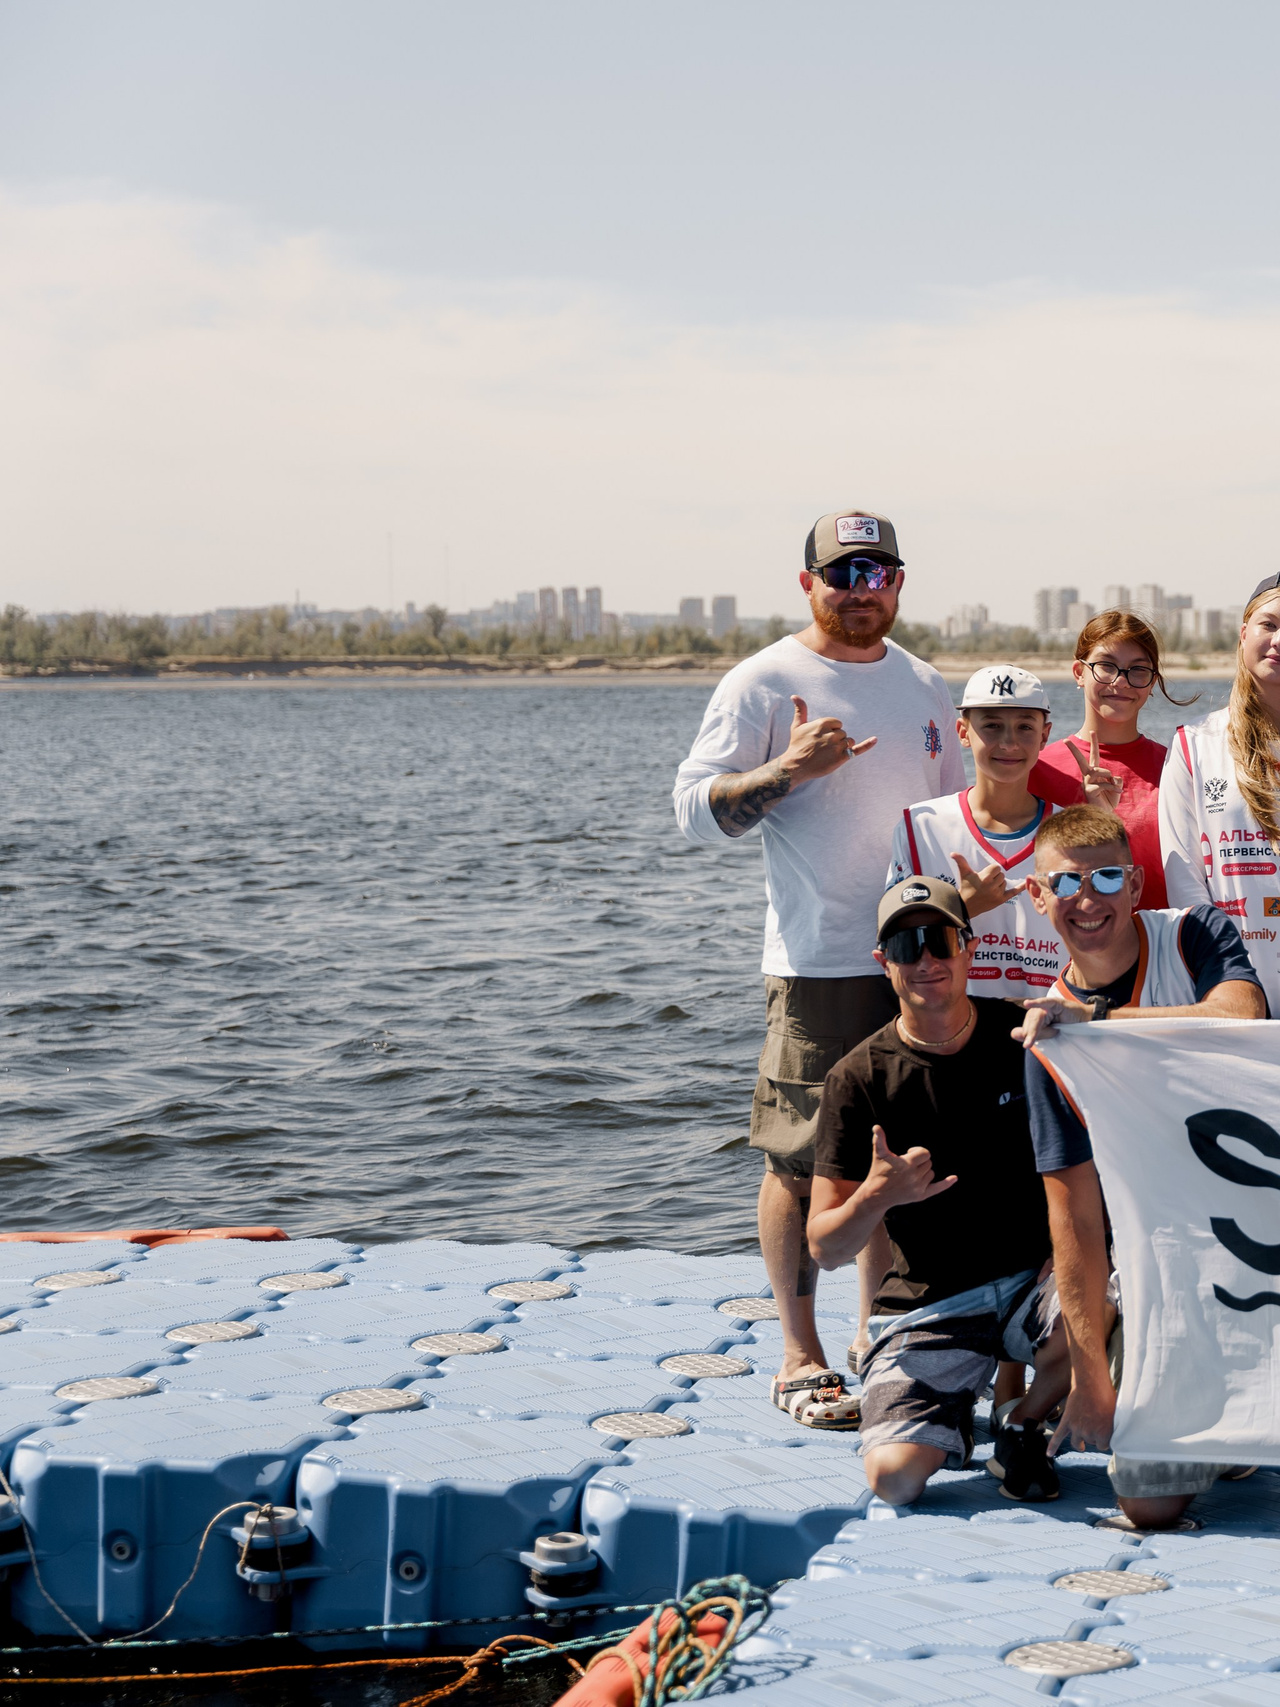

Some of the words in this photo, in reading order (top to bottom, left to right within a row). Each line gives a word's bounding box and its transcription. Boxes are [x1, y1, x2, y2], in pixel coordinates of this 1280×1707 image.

[990, 674, 1014, 696] NY
[1224, 865, 1273, 873] ВЕЙКСЕРФИНГ
[978, 932, 1060, 955] ФА-БАНК
[974, 951, 1020, 962] ЕНСТВО
